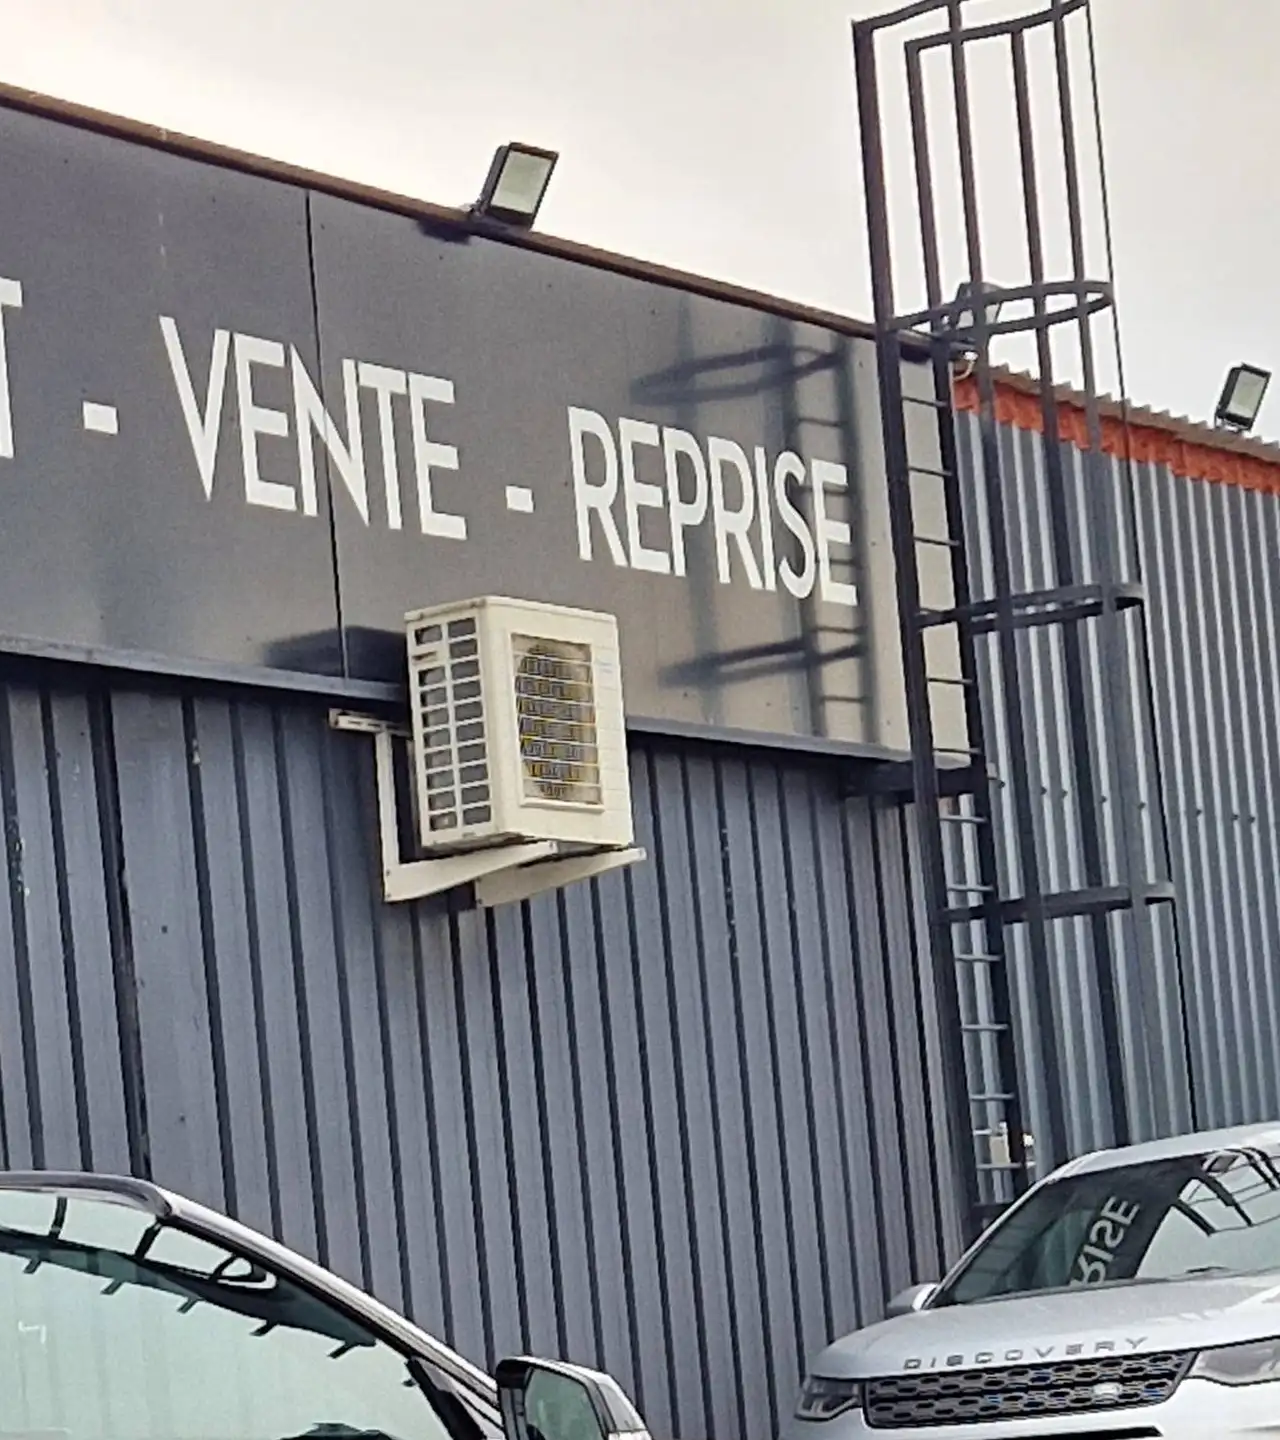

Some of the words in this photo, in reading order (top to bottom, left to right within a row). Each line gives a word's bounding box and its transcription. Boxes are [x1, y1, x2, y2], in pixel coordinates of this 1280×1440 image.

[159, 316, 468, 540] VENTE
[569, 406, 858, 606] REPRISE
[903, 1337, 1147, 1369] DISCOVERY
